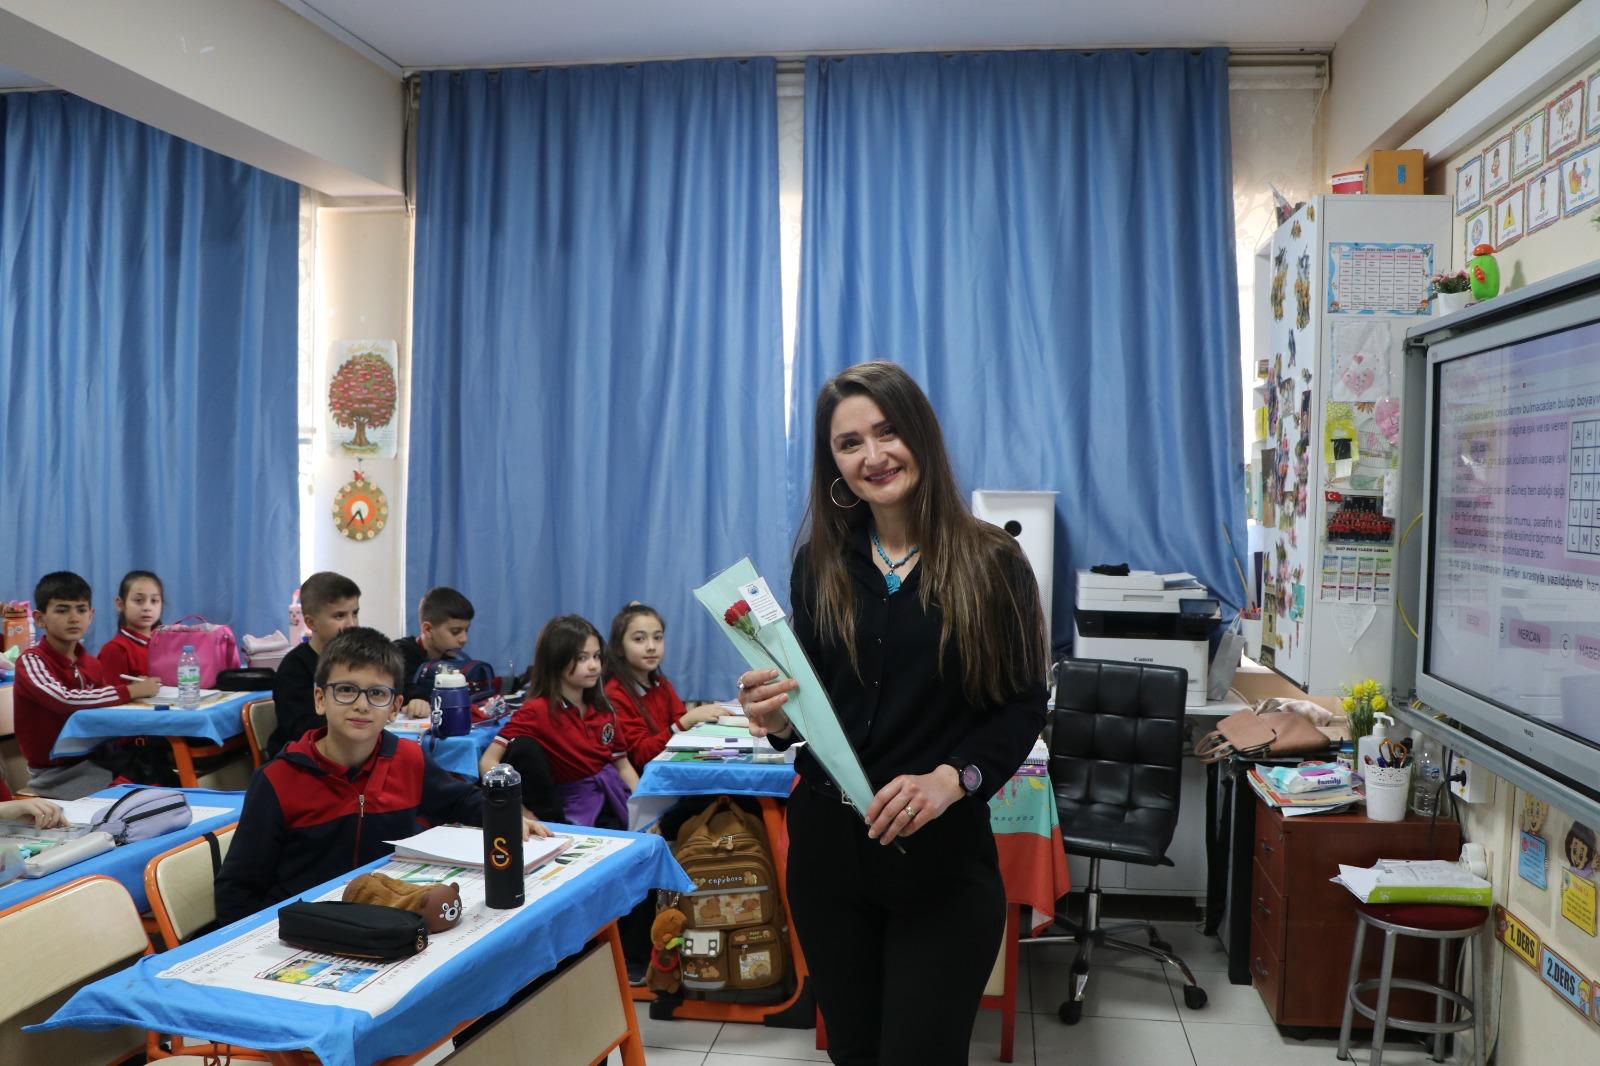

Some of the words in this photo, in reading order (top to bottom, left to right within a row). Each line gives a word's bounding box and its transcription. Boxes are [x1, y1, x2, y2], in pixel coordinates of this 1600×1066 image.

[1575, 430, 1581, 441] A
[1586, 429, 1593, 441] H
[1574, 455, 1580, 468] M
[1586, 454, 1592, 467] E
[1573, 481, 1578, 493] P
[1572, 508, 1578, 519] U
[1584, 508, 1590, 520] U
[1572, 534, 1576, 545] L
[1582, 534, 1588, 546] M
[1518, 628, 1542, 645] MERCAN
[1318, 777, 1342, 786] family
[1510, 924, 1516, 942] 1.
[1516, 928, 1535, 958] DERS
[1547, 957, 1576, 996] 2.DERS
